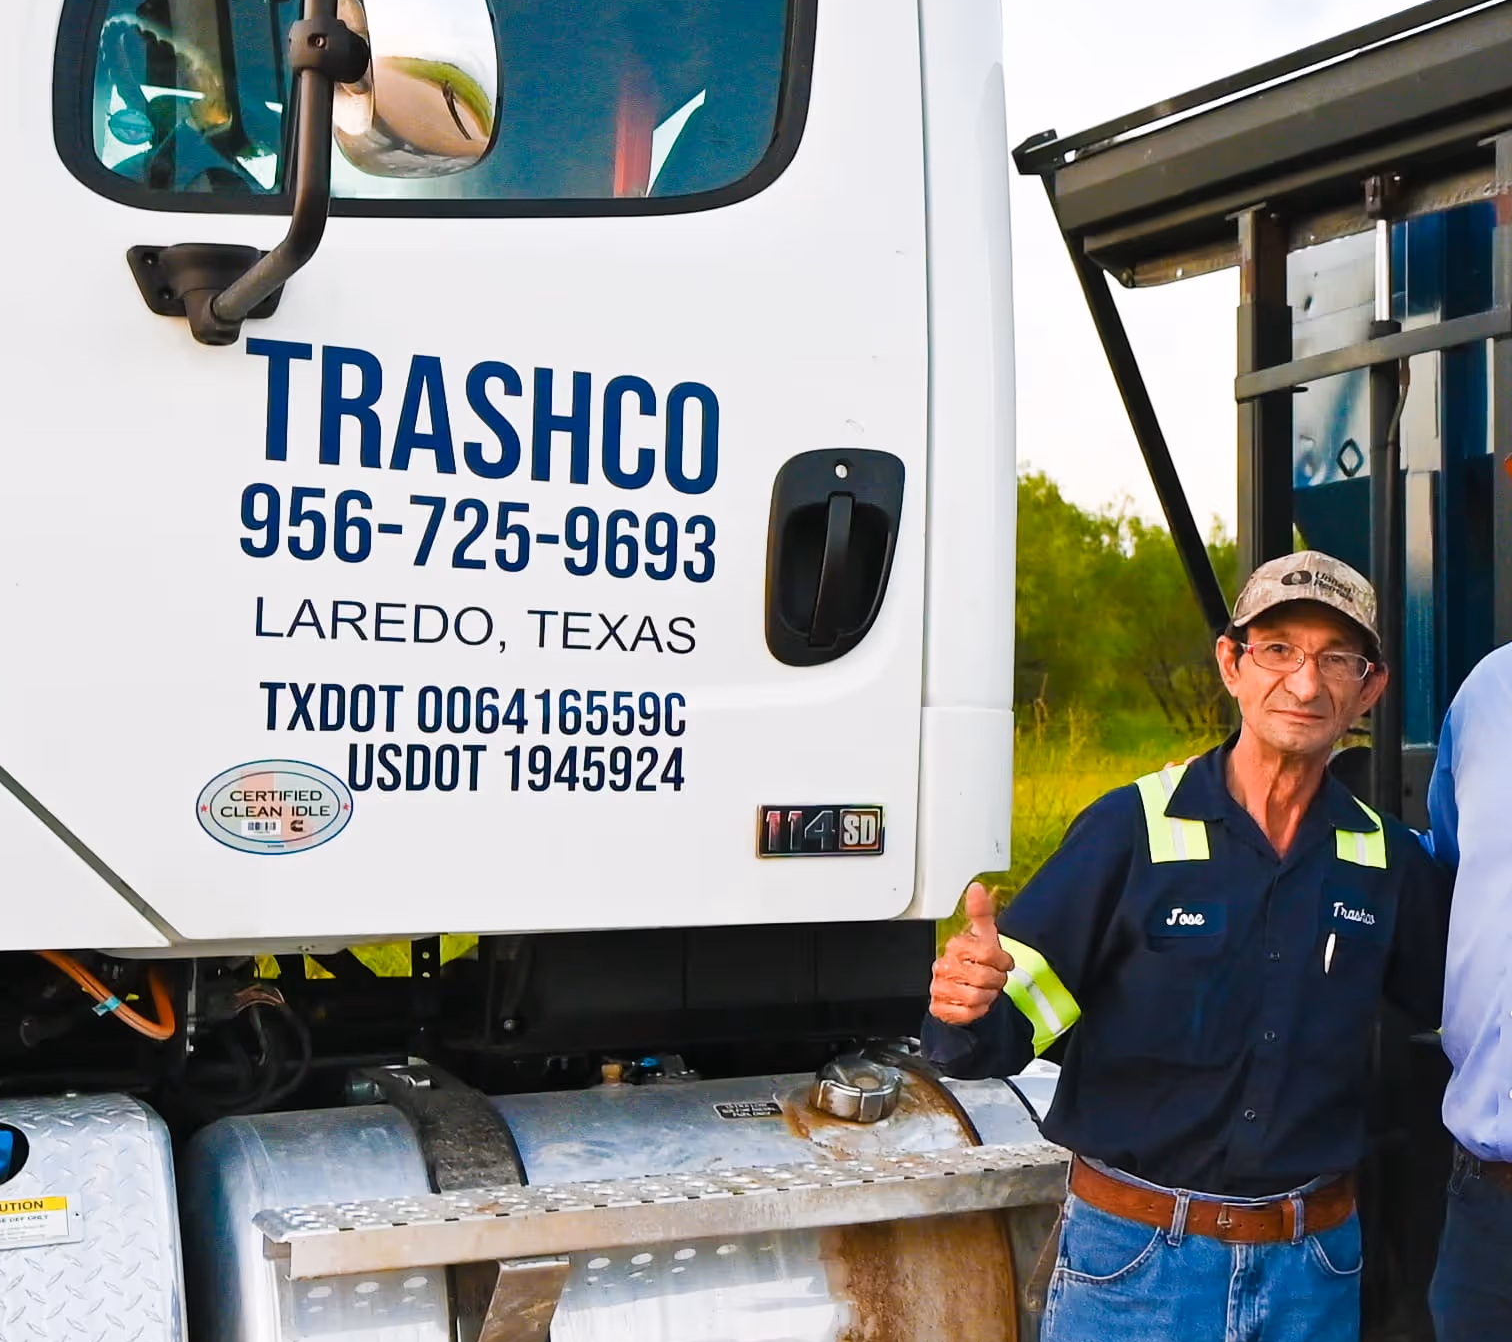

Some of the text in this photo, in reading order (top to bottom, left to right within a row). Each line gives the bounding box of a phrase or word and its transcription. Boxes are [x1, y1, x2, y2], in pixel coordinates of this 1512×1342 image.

[245, 336, 720, 495] TRASHCO
[239, 482, 716, 584] 956-725-9693
[255, 596, 696, 655] LAREDO, TEXAS
[259, 681, 686, 737] TXDOT 006416559C
[347, 743, 685, 792] USDOT 1945924
[220, 805, 331, 818] CLEAN IDLE
[229, 790, 323, 802] CERTIFIED
[765, 810, 876, 852] 114 SD
[1165, 908, 1206, 926] Jose
